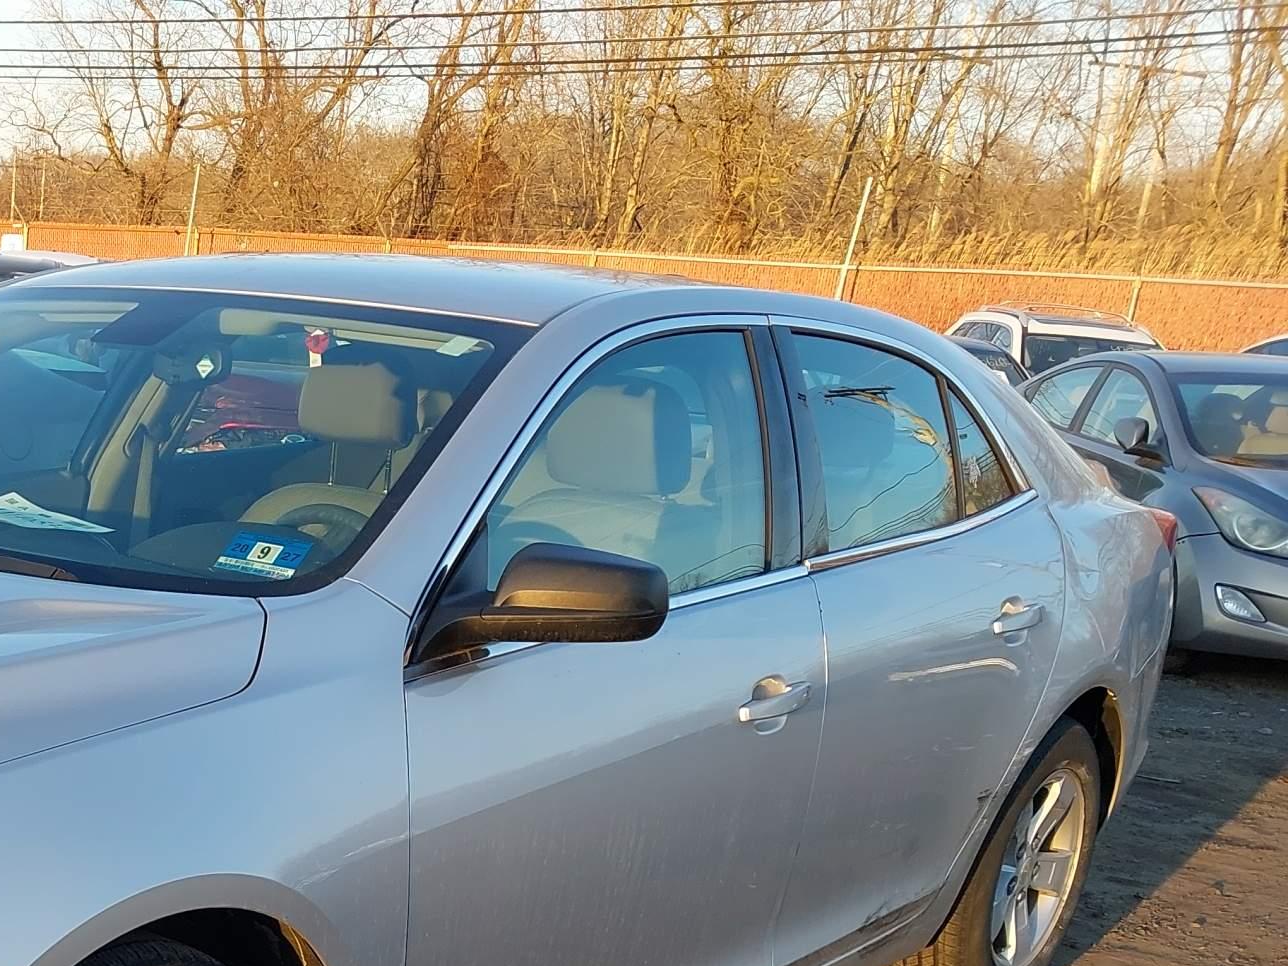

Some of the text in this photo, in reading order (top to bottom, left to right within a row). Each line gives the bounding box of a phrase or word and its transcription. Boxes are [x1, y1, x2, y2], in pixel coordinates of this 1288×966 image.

[231, 542, 301, 562] 20 9 27
